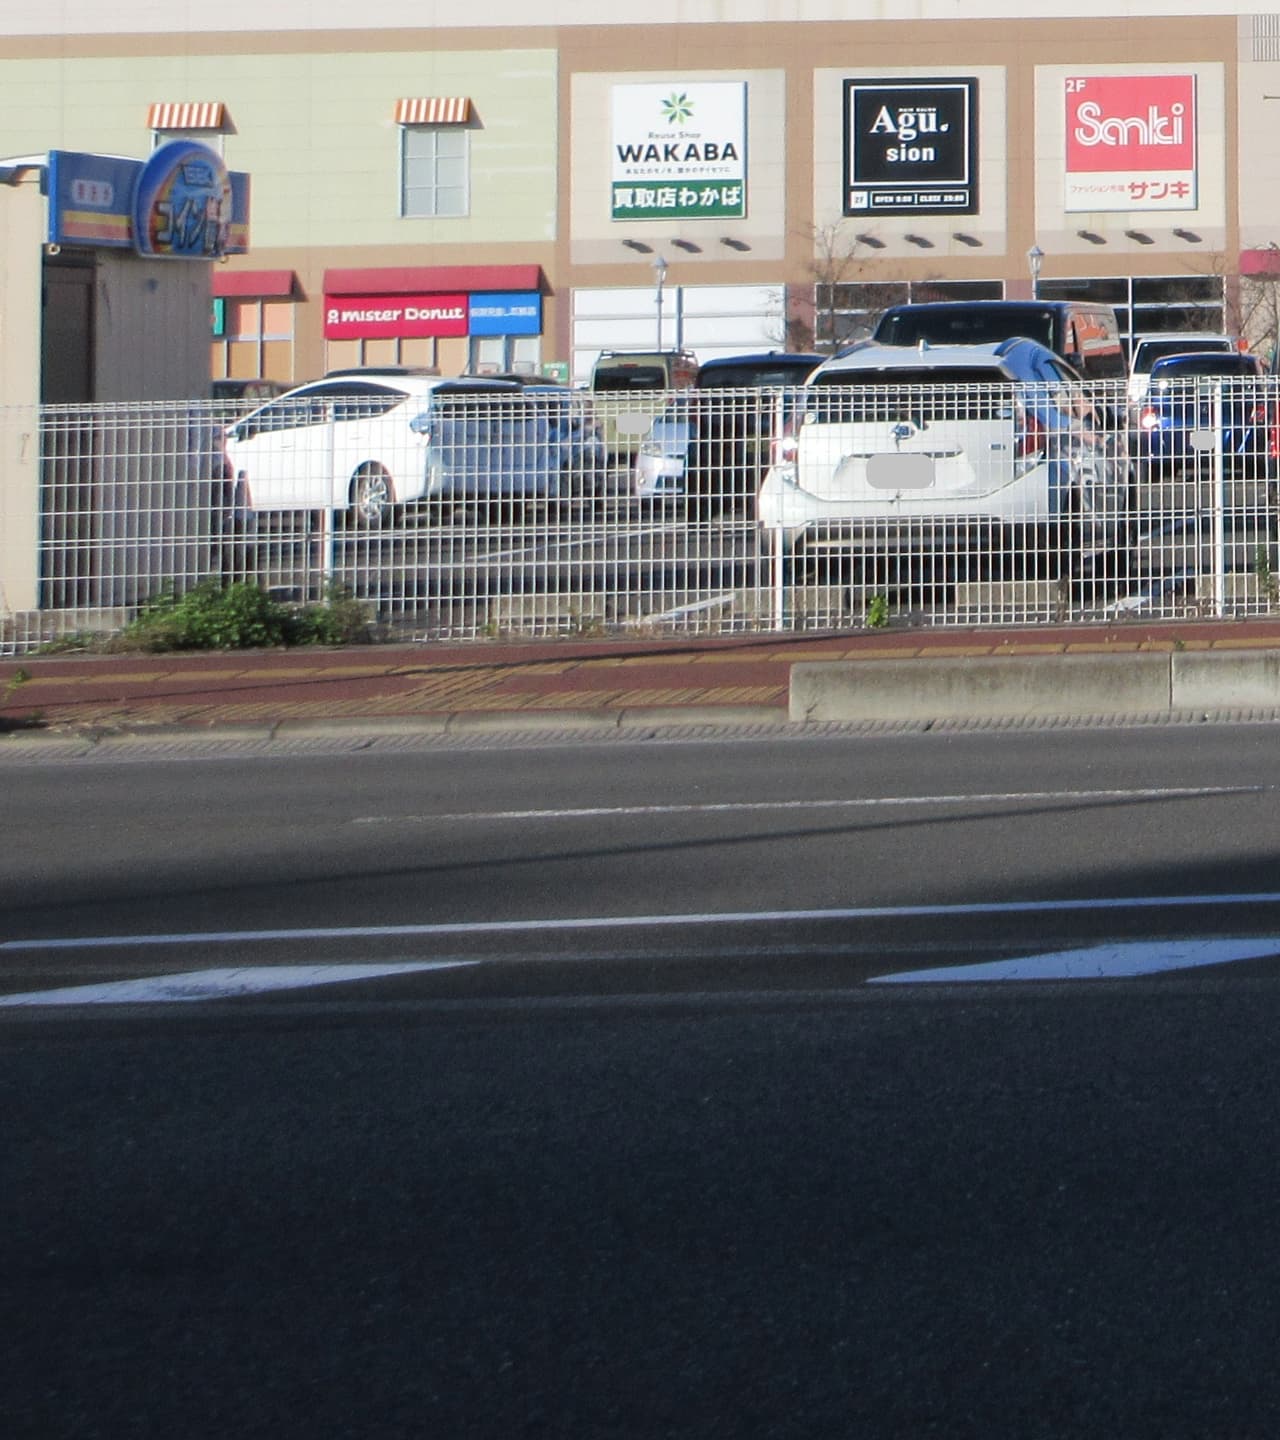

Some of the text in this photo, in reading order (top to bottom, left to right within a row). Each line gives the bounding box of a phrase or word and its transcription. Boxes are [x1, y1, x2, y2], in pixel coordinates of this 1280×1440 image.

[1066, 79, 1086, 92] 2F
[1074, 101, 1185, 146] Sanki
[616, 142, 739, 163] WAKABA
[886, 143, 935, 162] sion
[614, 186, 742, 209] 買取店わかば
[1128, 181, 1190, 200] サンキ
[404, 307, 465, 320] Donut
